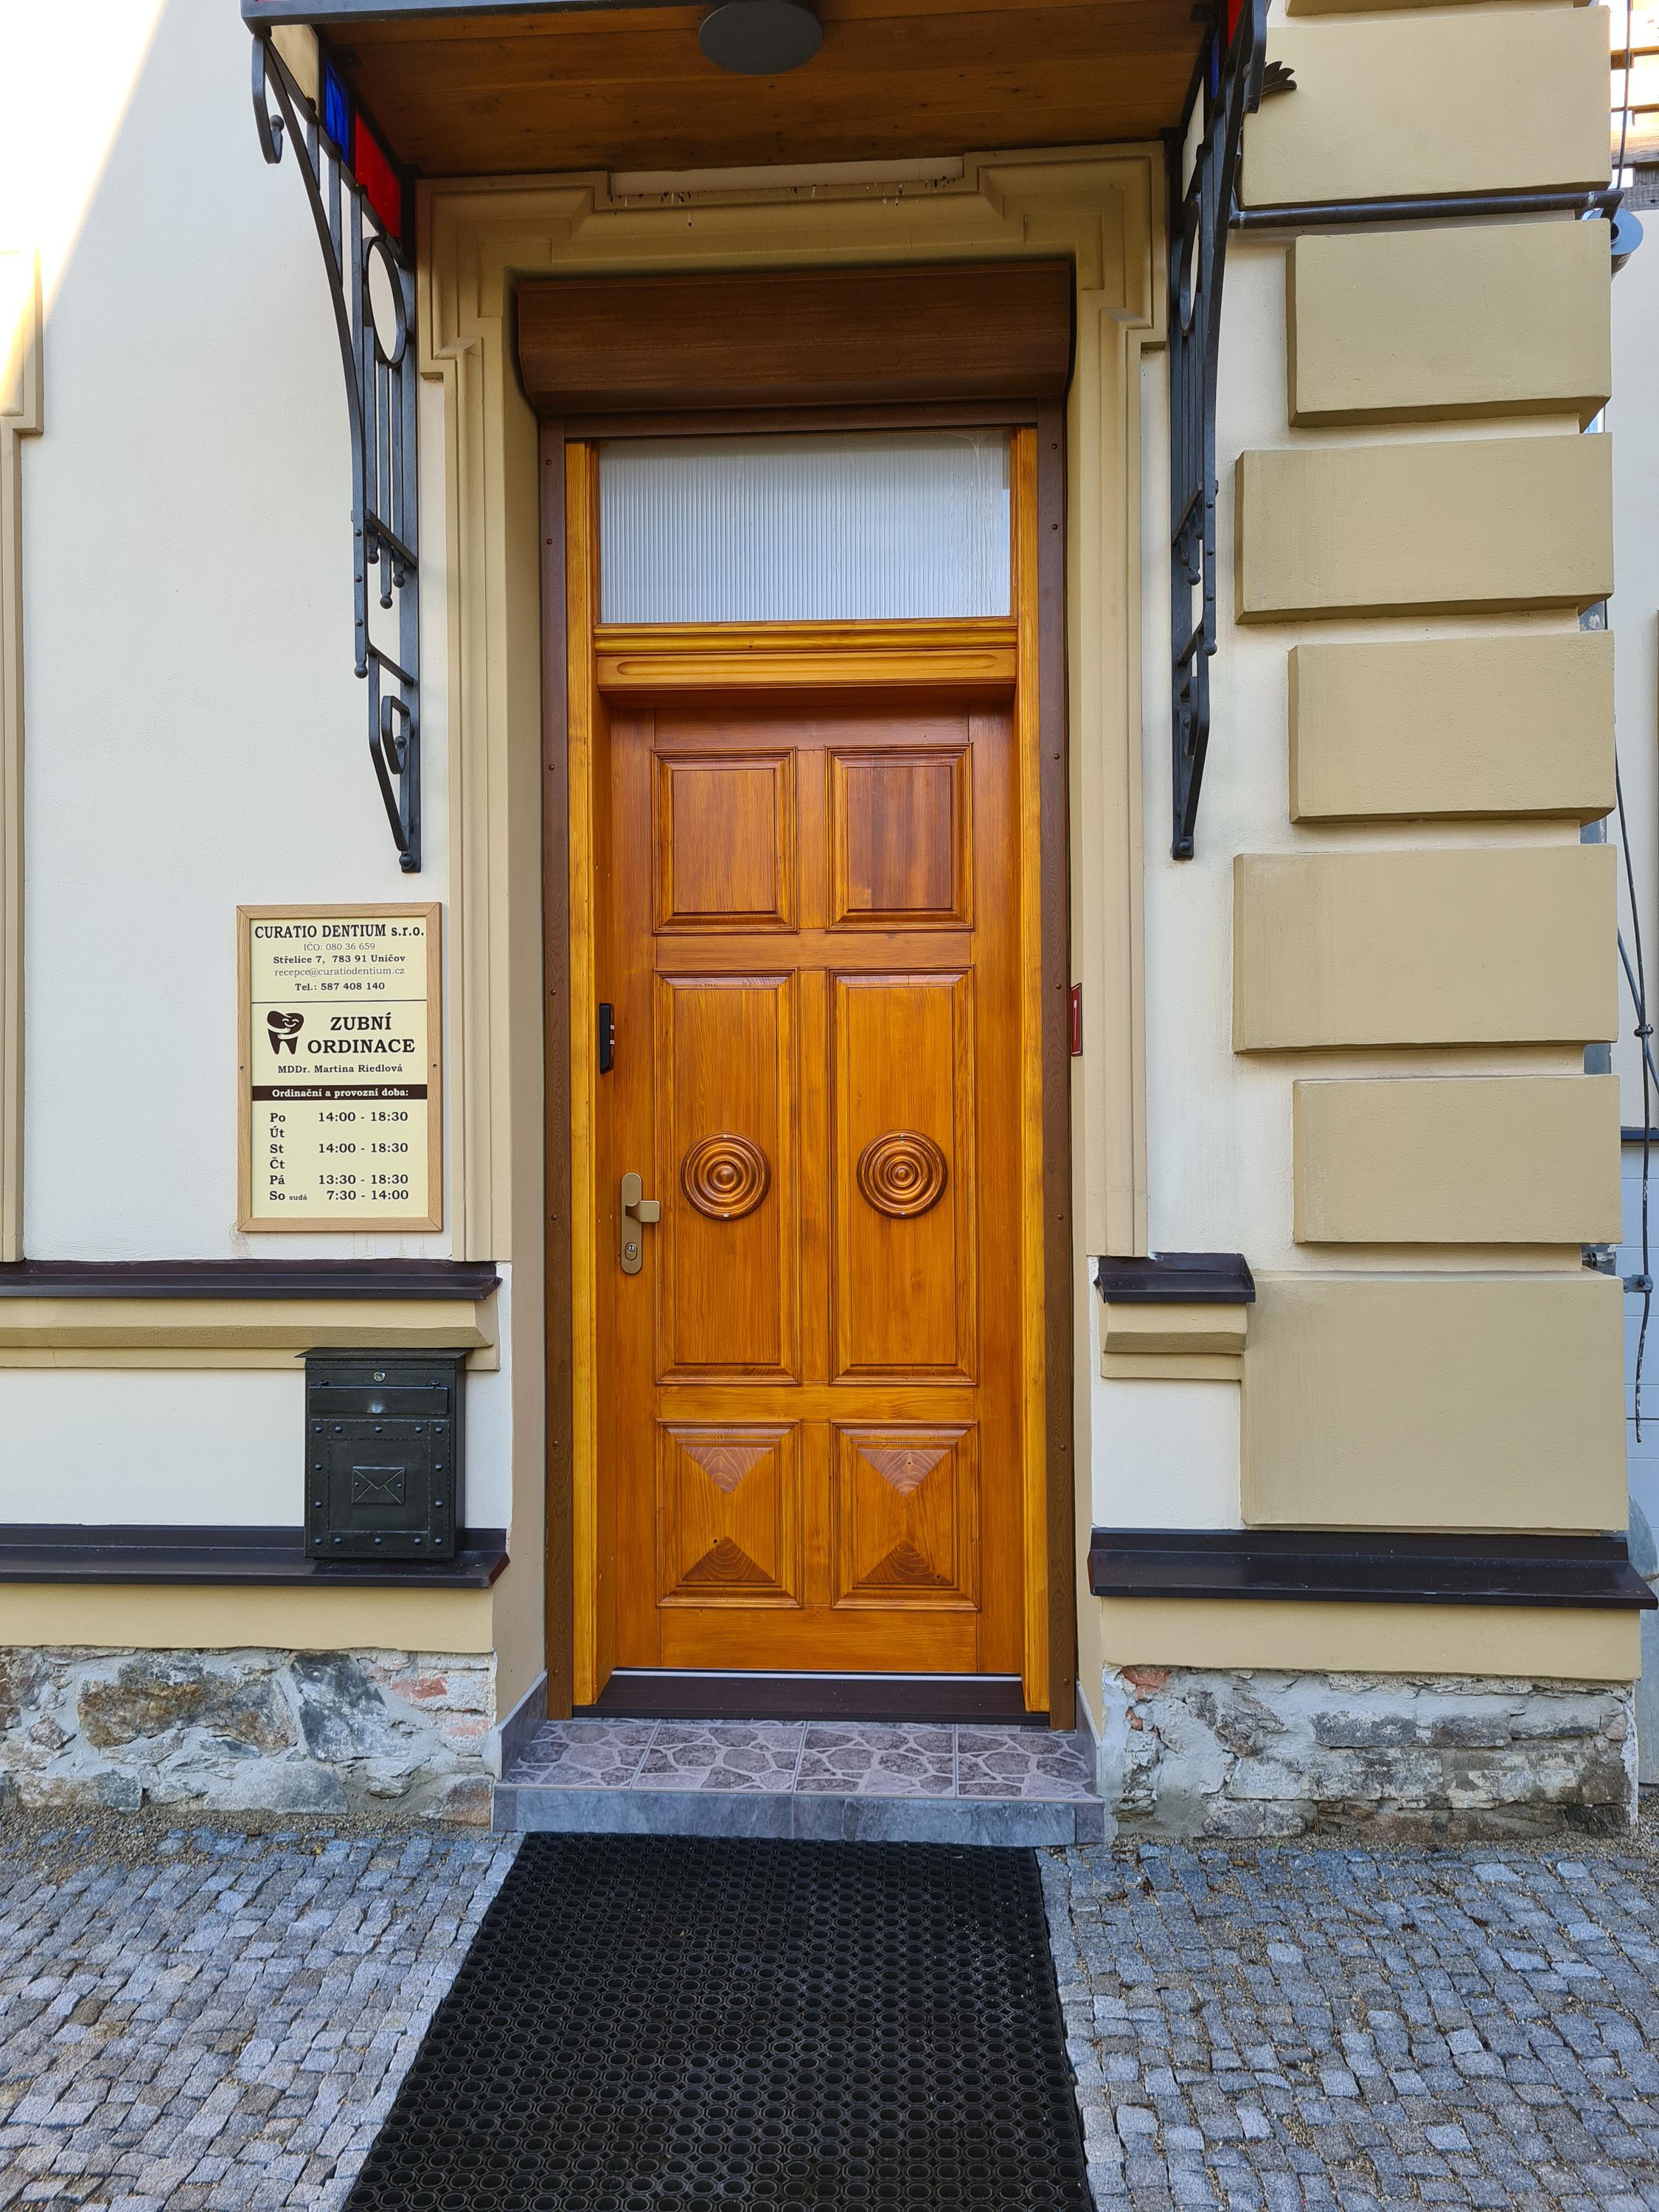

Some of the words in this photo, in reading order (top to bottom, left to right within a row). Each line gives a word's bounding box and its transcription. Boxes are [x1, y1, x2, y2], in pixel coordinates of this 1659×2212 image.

[255, 925, 317, 939] CURATIO
[322, 925, 386, 938] DENTIUM
[392, 927, 424, 936] s.r.o.
[304, 942, 323, 951] IČO:
[274, 956, 313, 964] Střelice
[316, 956, 325, 964] 7,
[355, 955, 366, 963] 91
[275, 967, 405, 978] recepce@curatiodentium.cz
[321, 983, 340, 991] 587
[330, 1012, 392, 1031] ZUBNÍ
[307, 1039, 416, 1054] ORDINACE
[278, 1065, 310, 1074] MDDr.
[314, 1065, 355, 1074] Martina
[358, 1064, 403, 1073] Riedlová
[272, 1089, 322, 1097] Ordinační
[334, 1088, 378, 1099] provozní
[382, 1088, 408, 1096] doba:
[270, 1113, 286, 1123] Po
[319, 1112, 356, 1122] 14:00
[372, 1112, 408, 1121] 18:30
[270, 1126, 285, 1138] Út
[271, 1144, 284, 1154] St
[319, 1144, 356, 1153] 14:00
[372, 1143, 408, 1153] 18:30
[270, 1157, 285, 1169] Čt
[270, 1175, 285, 1185] Pá
[319, 1175, 356, 1185] 13:30
[372, 1175, 408, 1185] 18:30
[270, 1191, 285, 1200] So
[327, 1191, 357, 1200] 7:30
[372, 1190, 409, 1200] 14:00
